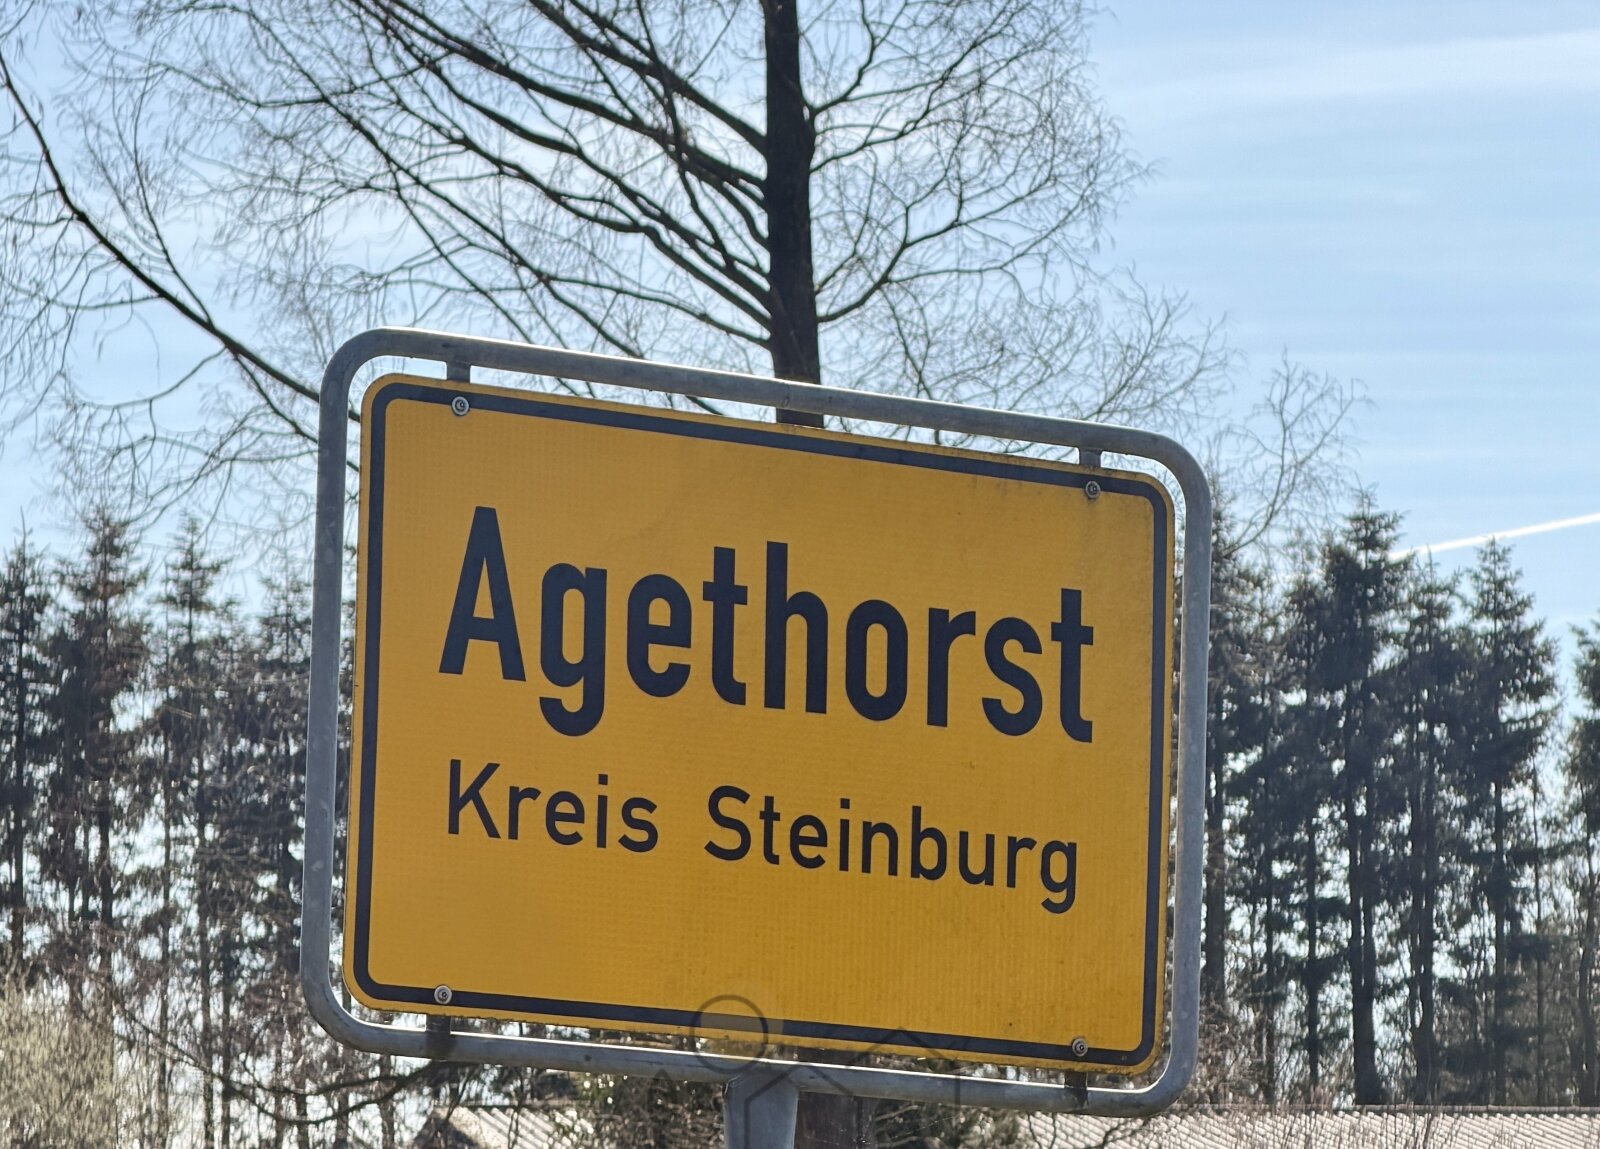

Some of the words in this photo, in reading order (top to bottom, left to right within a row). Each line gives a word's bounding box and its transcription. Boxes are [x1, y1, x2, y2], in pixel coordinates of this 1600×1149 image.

[439, 506, 1093, 743] Agethorst
[448, 759, 658, 852] Kreis
[704, 785, 1077, 914] Steinburg
